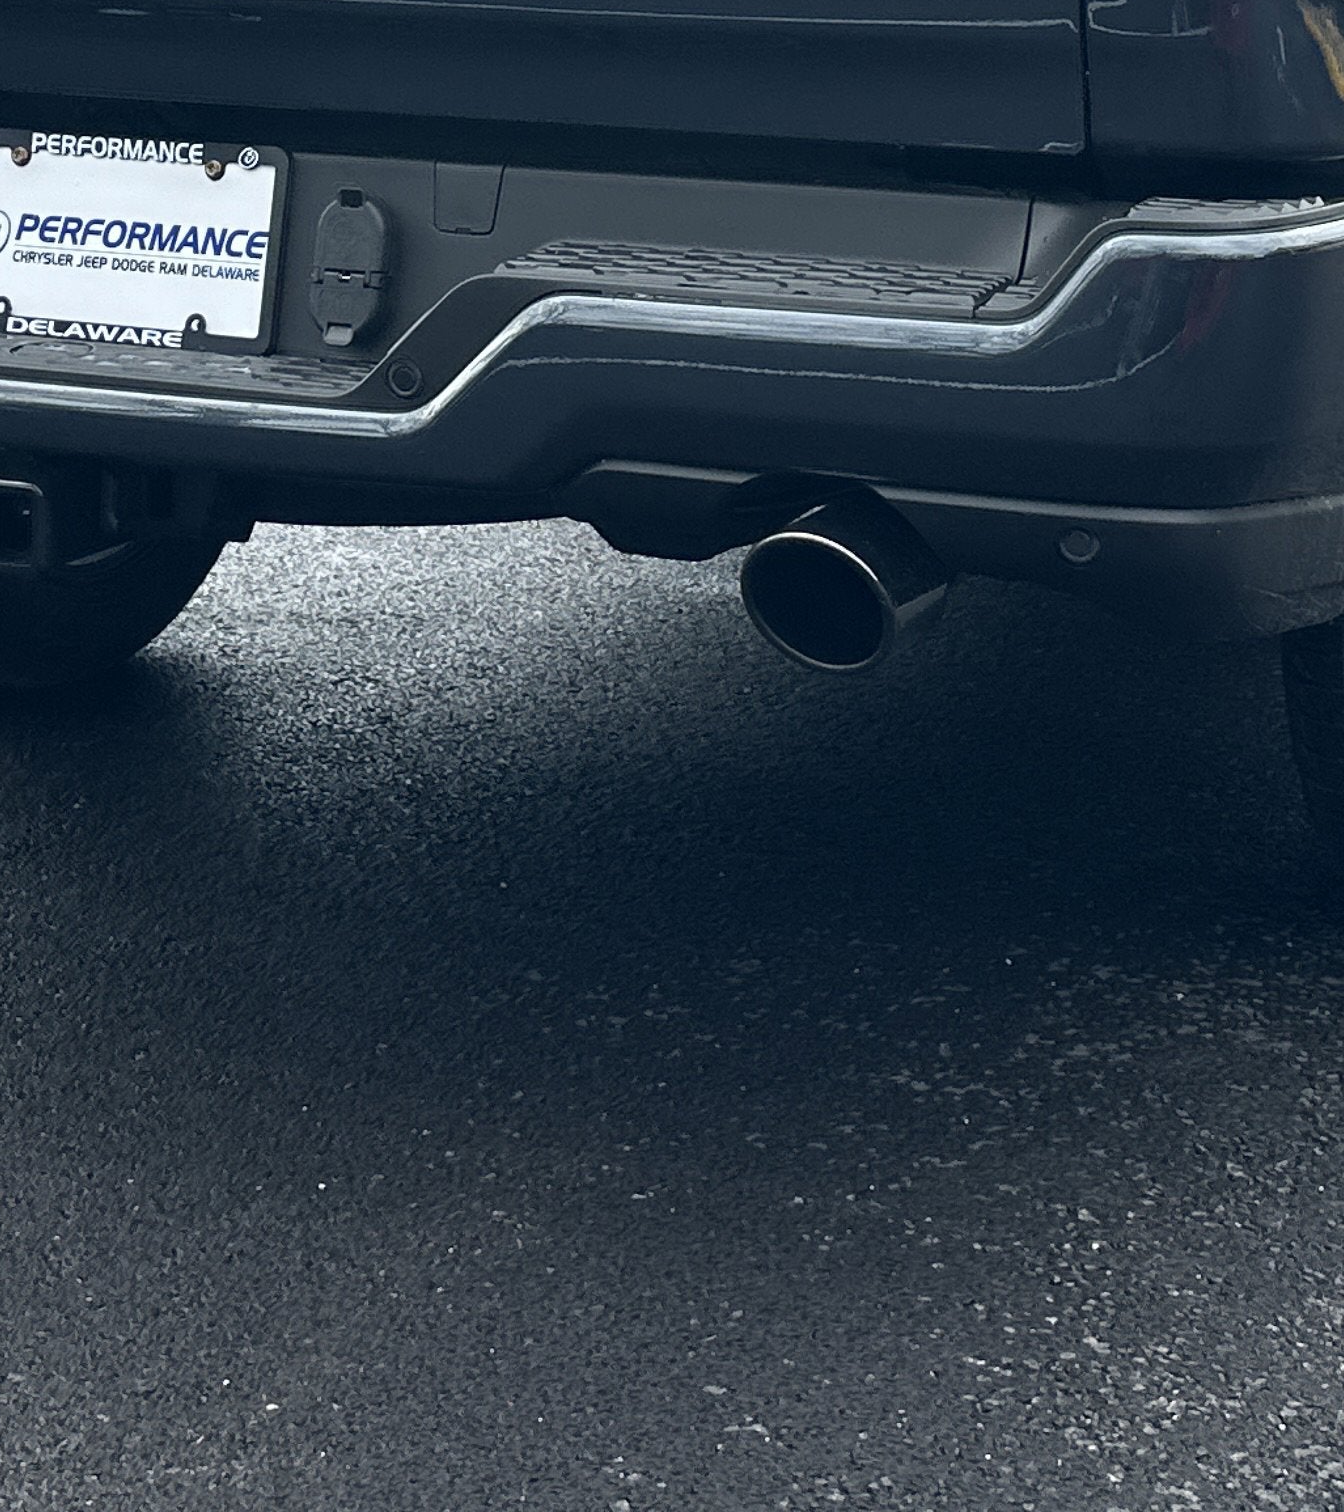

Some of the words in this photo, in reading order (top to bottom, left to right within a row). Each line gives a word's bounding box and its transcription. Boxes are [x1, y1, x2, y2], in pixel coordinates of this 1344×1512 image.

[31, 131, 204, 165] PERFORMANCE
[14, 213, 271, 259] PERFORMANCE
[12, 249, 74, 268] CHRYSLER
[76, 257, 108, 270] JEEP
[112, 259, 156, 274] DODGE
[159, 263, 188, 277] RAM
[191, 265, 260, 282] DELAWARE
[6, 317, 183, 349] DELAWARE
